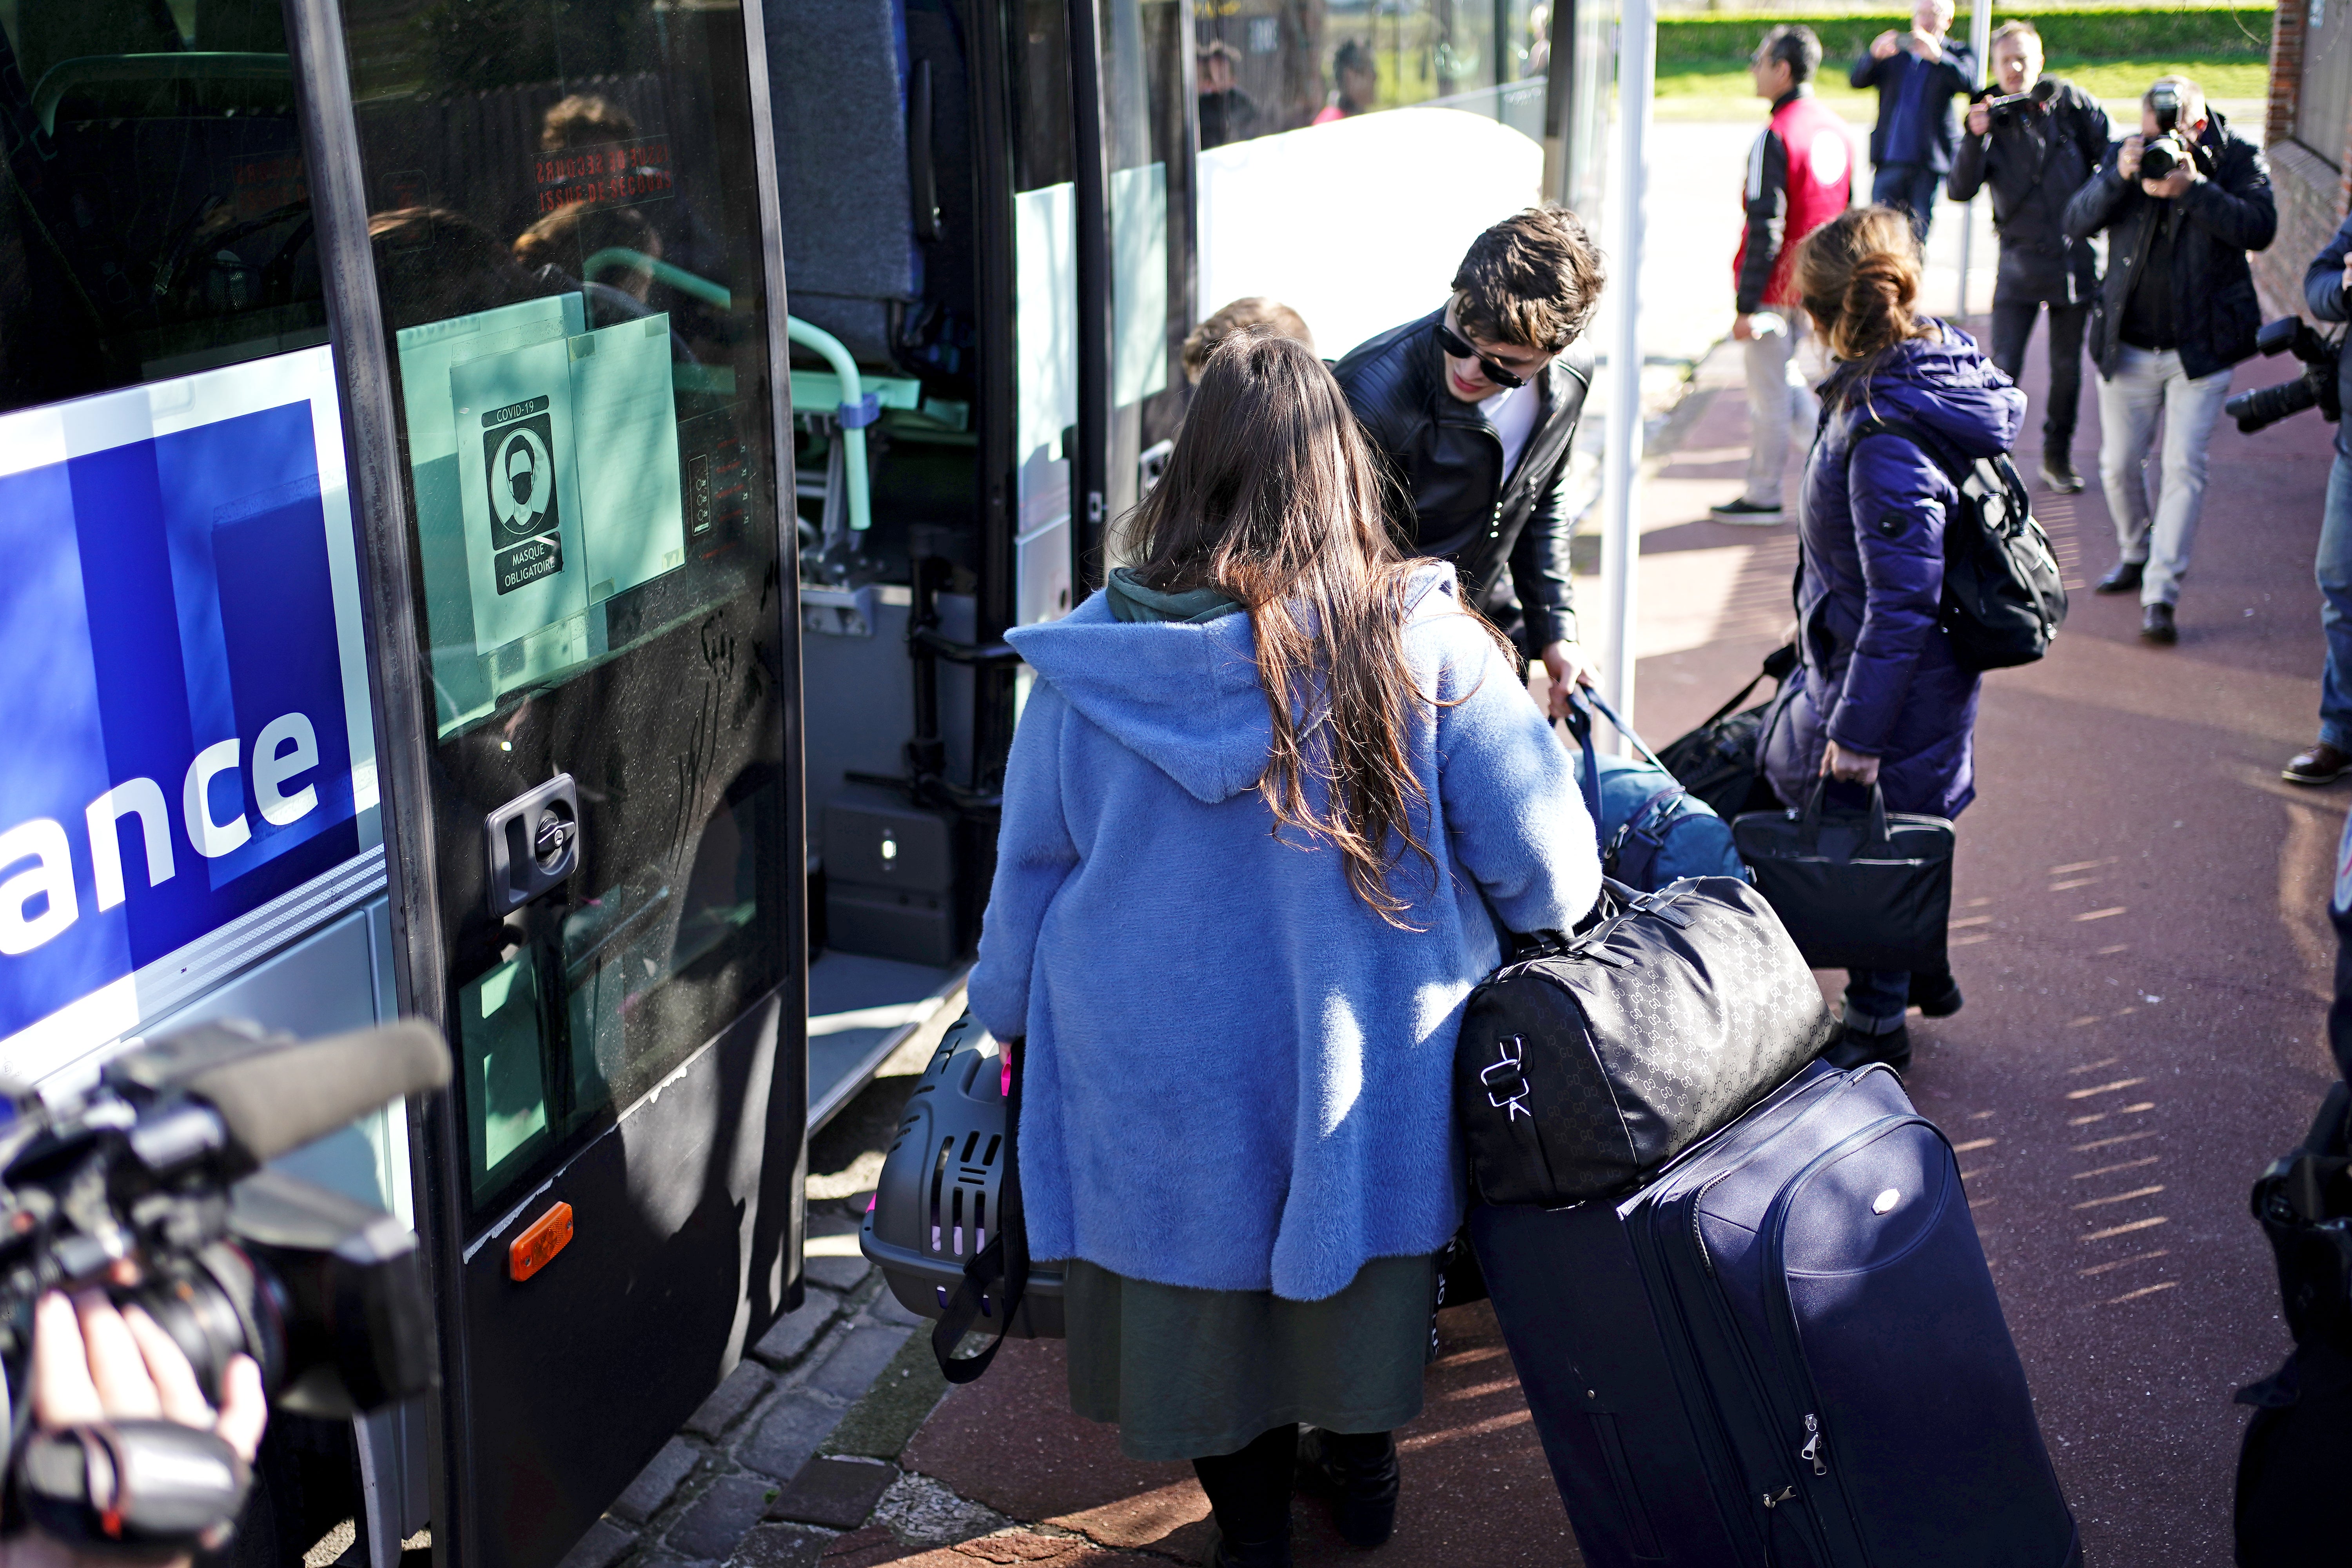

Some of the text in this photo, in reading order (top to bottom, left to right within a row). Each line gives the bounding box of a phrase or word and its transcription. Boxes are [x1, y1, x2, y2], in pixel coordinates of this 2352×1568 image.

[539, 170, 672, 212] ISSUE DE SECOURS
[496, 400, 534, 423] COVID-19
[512, 542, 545, 566] MASQUE
[504, 556, 555, 588] OBLIGATOIRE
[1437, 1273, 1446, 1305] OF
